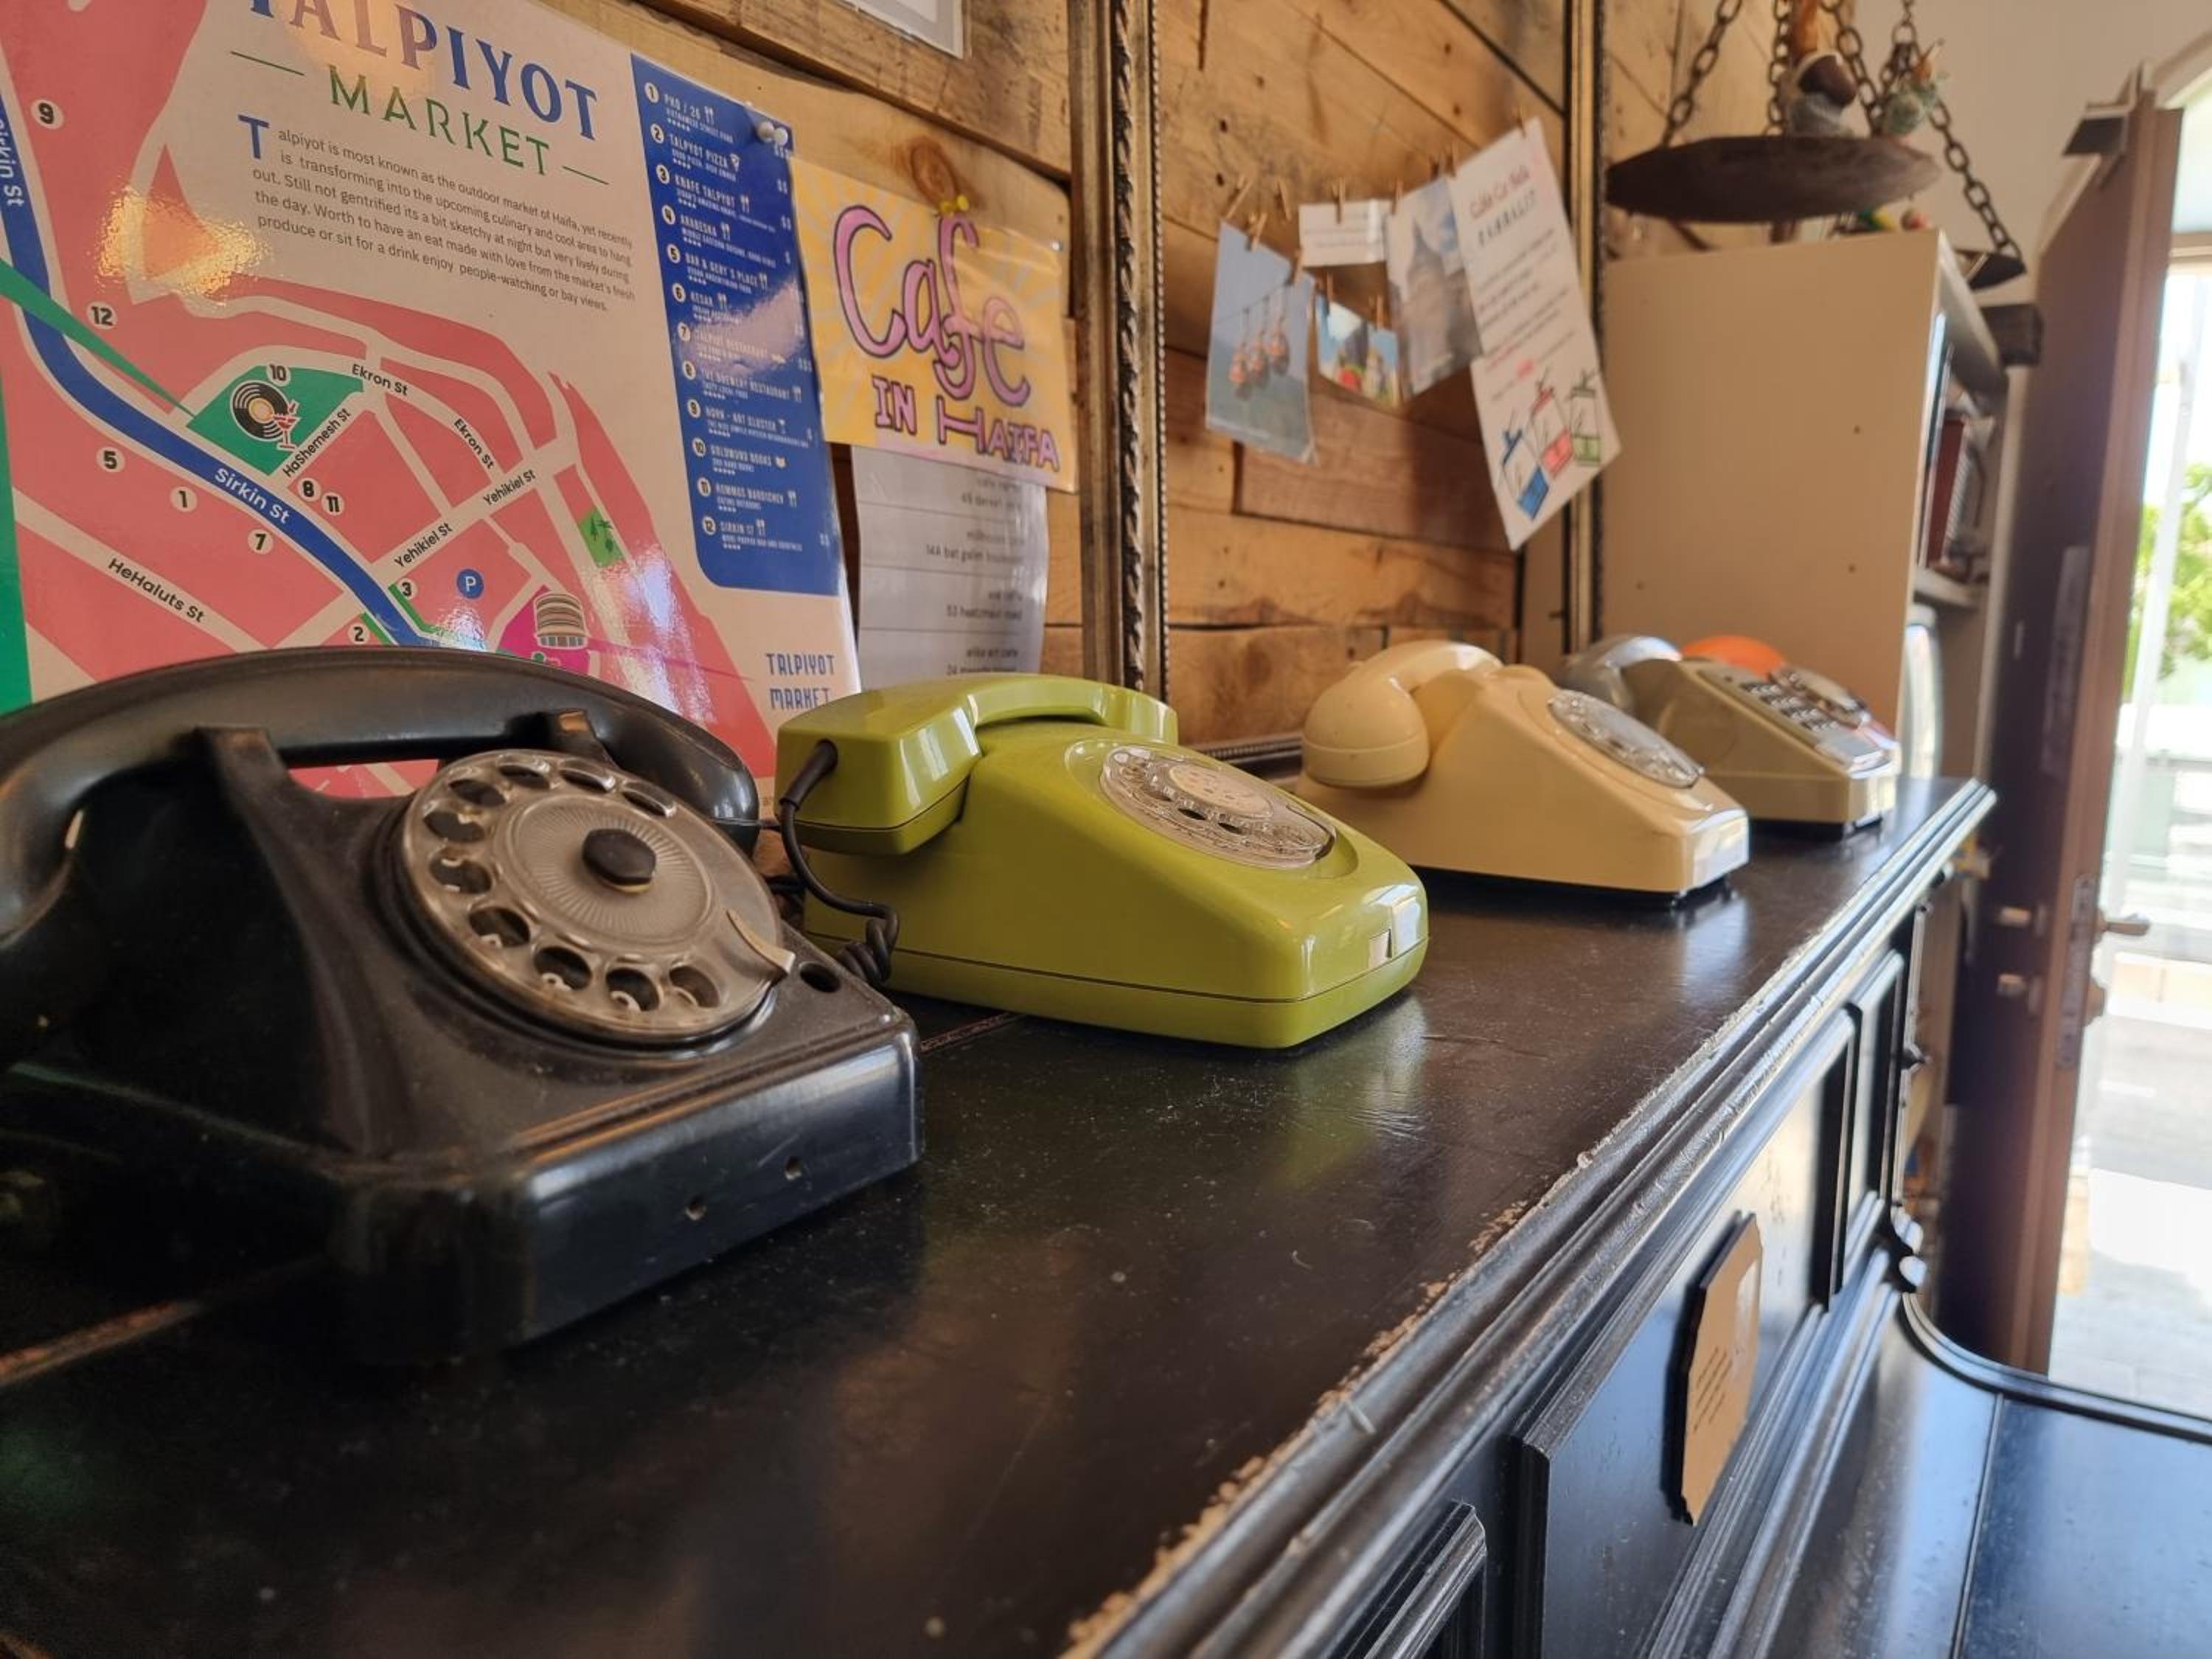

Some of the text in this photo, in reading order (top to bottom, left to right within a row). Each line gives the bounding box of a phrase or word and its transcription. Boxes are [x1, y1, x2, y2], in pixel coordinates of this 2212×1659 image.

[38, 102, 55, 125] 9
[327, 64, 549, 176] MARKET
[654, 127, 661, 139] 2
[4, 185, 24, 206] St
[328, 142, 340, 156] is
[343, 147, 375, 166] most
[378, 156, 419, 178] known
[421, 171, 435, 184] as
[438, 175, 456, 189] the
[458, 184, 500, 204] outdoor
[503, 197, 538, 216] market
[540, 208, 551, 218] of
[552, 213, 580, 232] Haifa,
[581, 223, 597, 238] yet
[598, 229, 633, 249] recently
[281, 150, 293, 165] is
[299, 156, 384, 192] transforming
[386, 181, 410, 197] into
[413, 189, 433, 204] the
[435, 196, 490, 223] upcoming
[492, 212, 532, 236] culinary
[535, 226, 552, 240] and
[555, 232, 575, 248] cool
[599, 246, 608, 257] to
[611, 248, 632, 267] hang
[253, 168, 281, 185] out.
[285, 174, 311, 192] Still
[315, 184, 336, 198] not
[340, 189, 401, 215] gentrified
[405, 204, 419, 220] its
[422, 214, 429, 224] a
[431, 213, 447, 228] bit
[450, 219, 492, 243] sketchy
[494, 234, 504, 246] at
[507, 237, 532, 254] night
[535, 243, 551, 257] but
[554, 251, 574, 266] very
[601, 265, 630, 284] during
[255, 190, 279, 206] the
[282, 196, 310, 215] day.
[313, 204, 355, 225] Worth
[358, 215, 371, 229] to
[375, 219, 408, 237] have
[407, 230, 422, 243] an
[425, 234, 443, 246] eat
[446, 240, 478, 257] made
[480, 247, 502, 262] with
[505, 252, 526, 271] love
[528, 260, 552, 277] from
[554, 268, 570, 282] the
[257, 215, 316, 237] produce
[319, 229, 333, 240] or
[336, 232, 352, 246] sit
[356, 235, 375, 251] for
[378, 243, 385, 254] a
[389, 243, 420, 262] drink
[422, 254, 454, 272] enjoy
[549, 289, 560, 300] or
[561, 289, 580, 305] bay
[91, 306, 113, 326] 12
[833, 204, 1031, 406] Cafe
[270, 364, 286, 382] 10
[352, 364, 408, 397] Ekron St
[872, 374, 1060, 472] IN HAIFA
[282, 408, 351, 478] HaShemesh St
[453, 418, 495, 470] Ekron St
[103, 451, 116, 469] 5
[178, 491, 188, 508] 1
[215, 467, 290, 524] Sirkin St
[302, 481, 315, 498] 8
[483, 469, 535, 507] Yehikiel St
[326, 496, 340, 512] 11
[706, 520, 714, 532] 12
[255, 534, 267, 551] 7
[394, 522, 453, 569] Yehikiel St
[108, 557, 206, 624] HeHaluts St
[402, 582, 413, 596] 3
[465, 576, 476, 591] P
[353, 627, 365, 642] 2
[765, 653, 835, 675] TALPIYOT
[770, 688, 831, 710] MARKET
